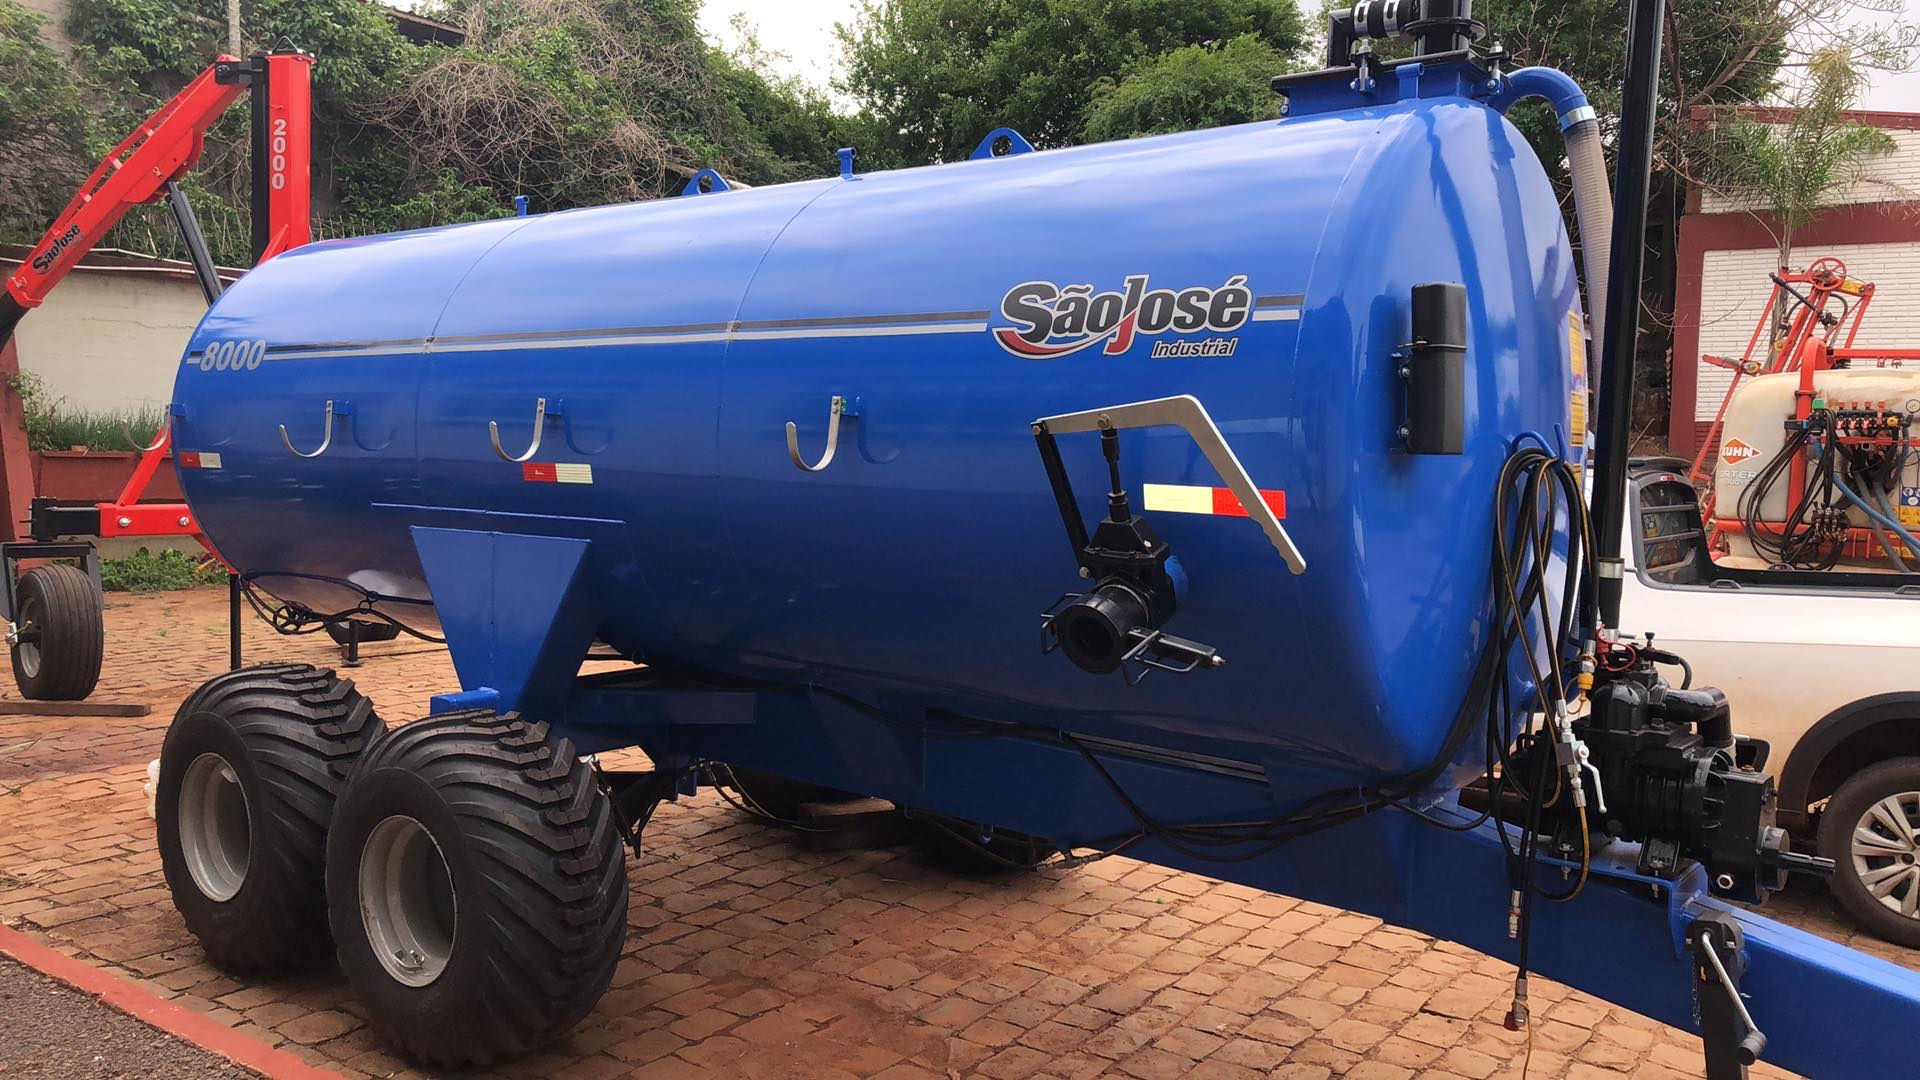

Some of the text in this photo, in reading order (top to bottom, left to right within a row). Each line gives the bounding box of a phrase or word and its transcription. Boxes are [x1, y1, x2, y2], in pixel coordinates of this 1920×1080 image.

[271, 118, 288, 191] 2000
[199, 339, 267, 372] 8000
[1150, 337, 1239, 360] Industrial
